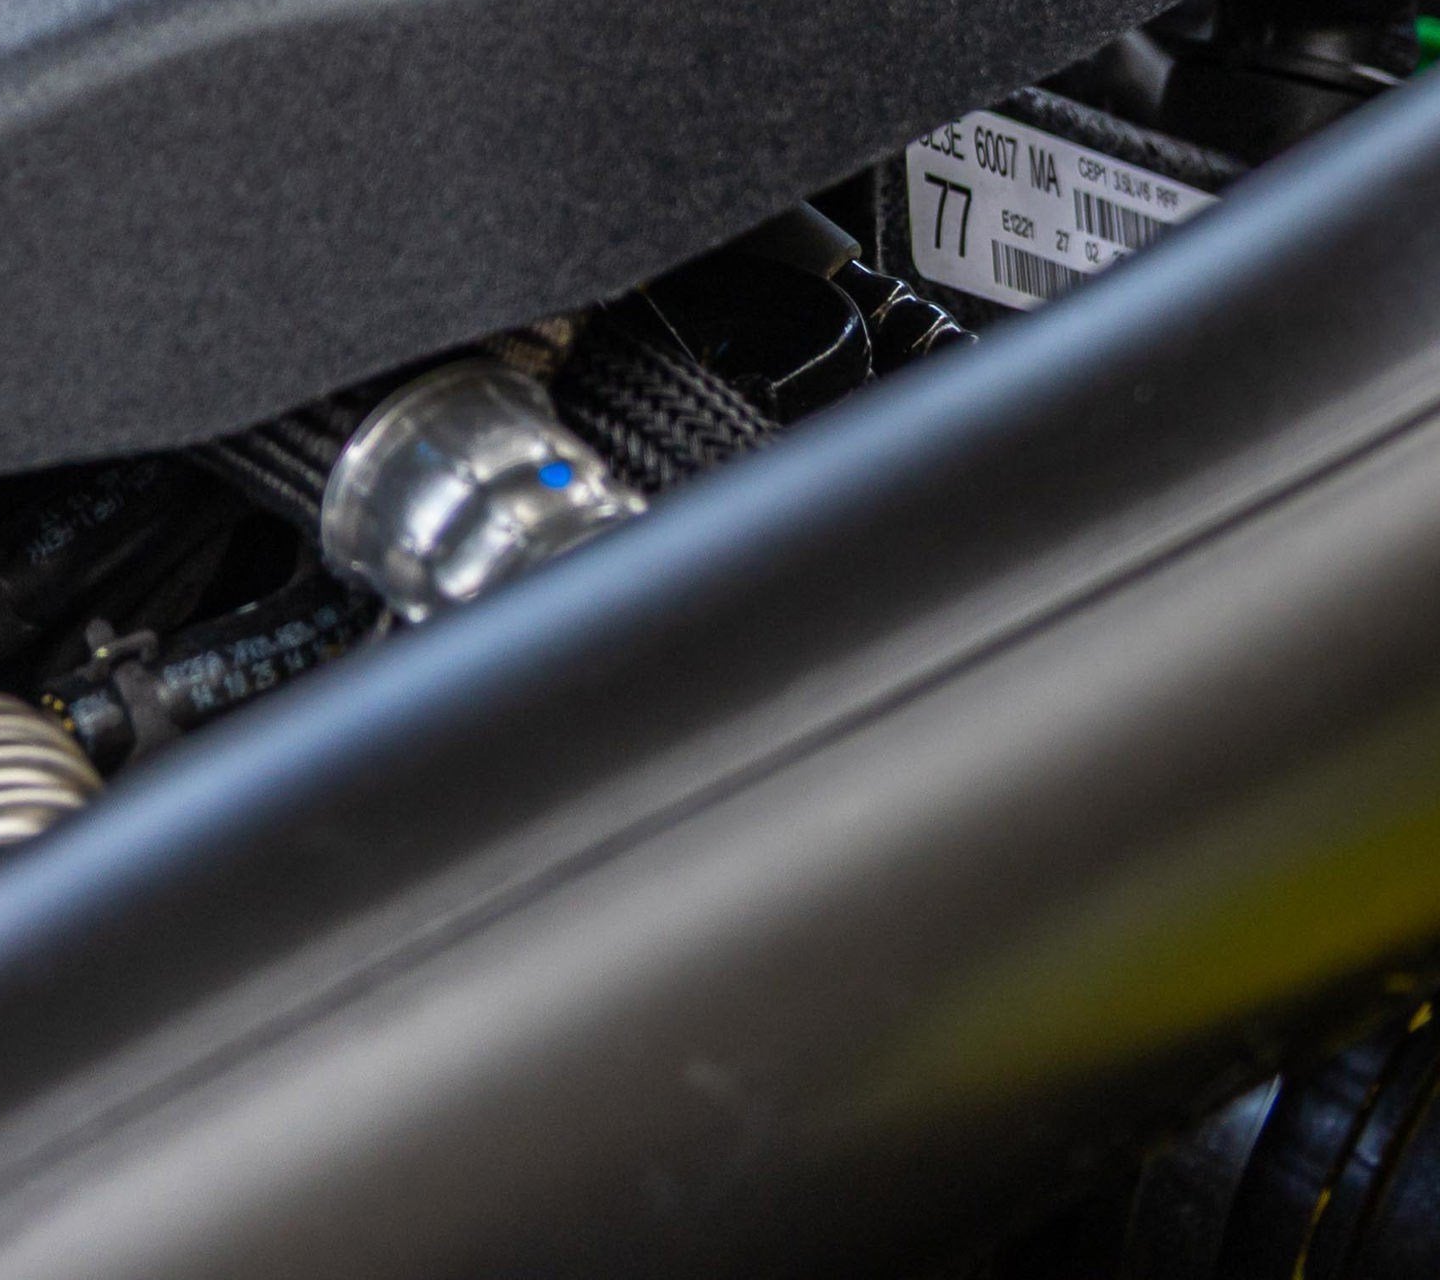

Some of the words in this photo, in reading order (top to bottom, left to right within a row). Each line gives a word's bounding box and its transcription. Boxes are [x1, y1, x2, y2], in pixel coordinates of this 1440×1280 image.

[974, 125, 1018, 180] 6007
[1028, 145, 1062, 198] MA
[924, 171, 973, 258] 77
[1055, 229, 1071, 254] 27
